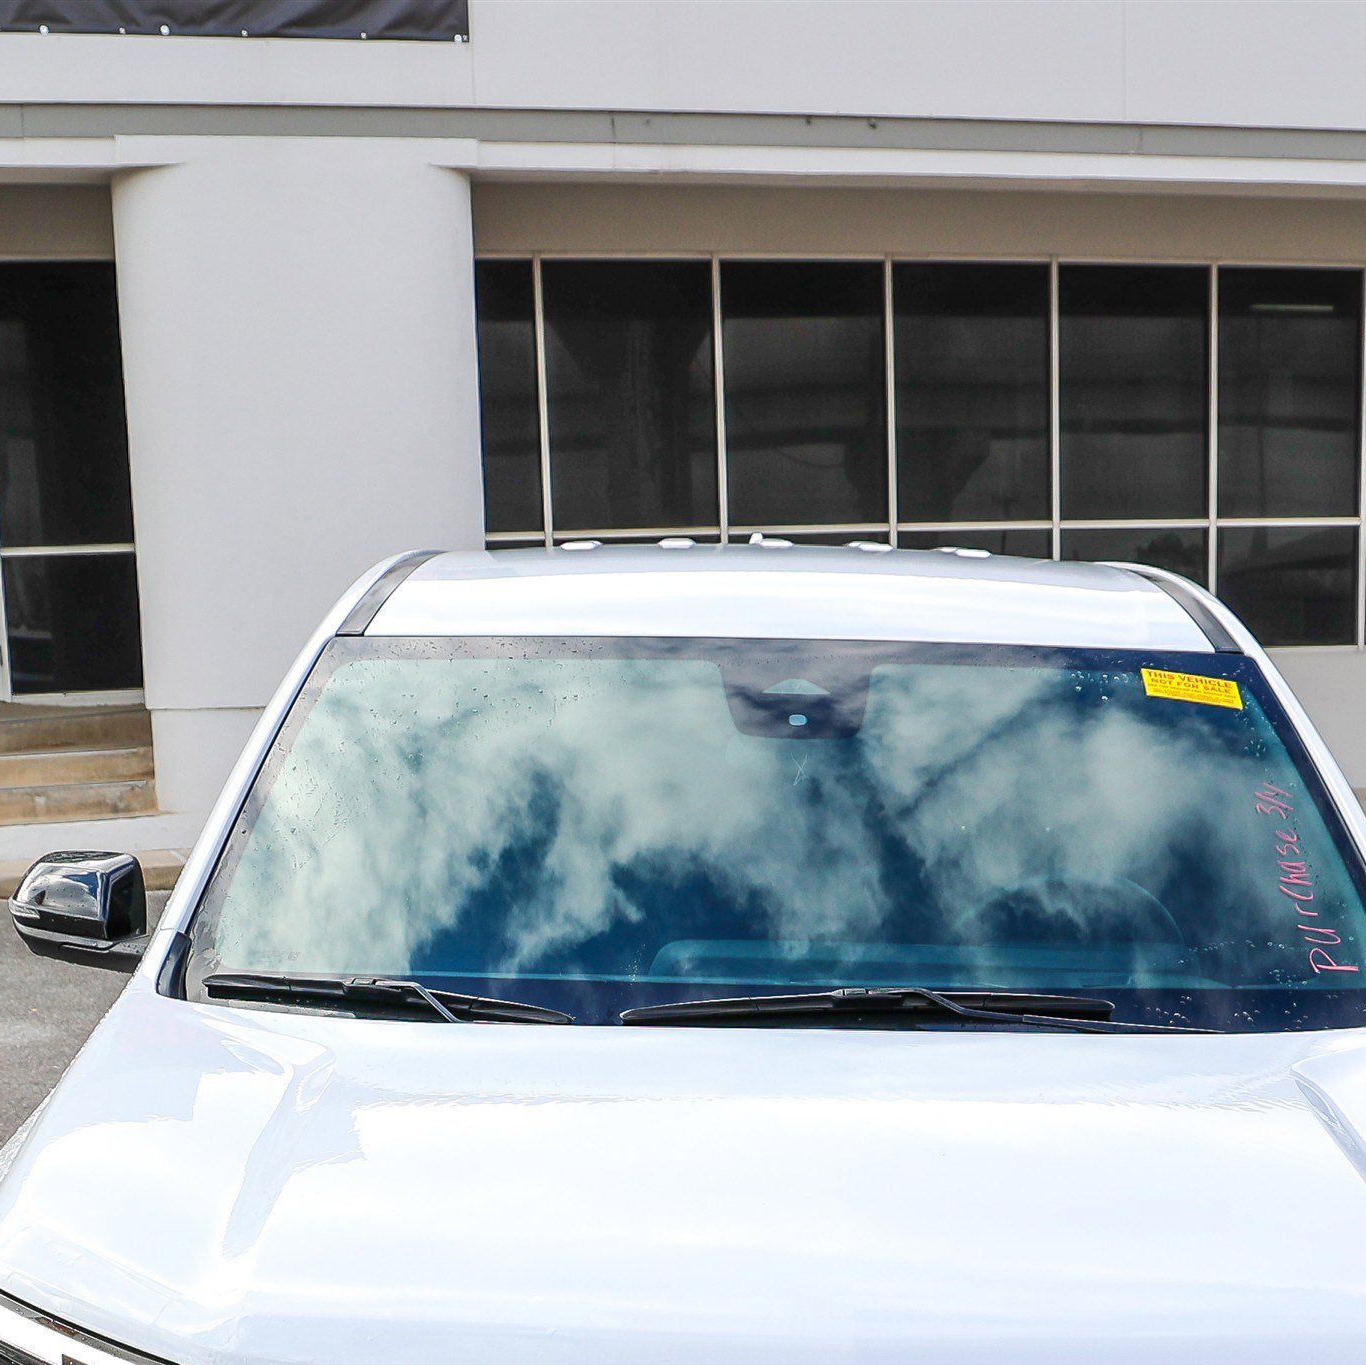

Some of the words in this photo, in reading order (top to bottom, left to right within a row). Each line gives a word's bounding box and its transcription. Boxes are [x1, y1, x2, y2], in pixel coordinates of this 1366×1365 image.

[1147, 670, 1176, 681] THIS
[1179, 674, 1233, 689] VEHICLE
[1151, 677, 1174, 686] NOT
[1177, 680, 1199, 690] FOR
[1203, 685, 1232, 694] SALE
